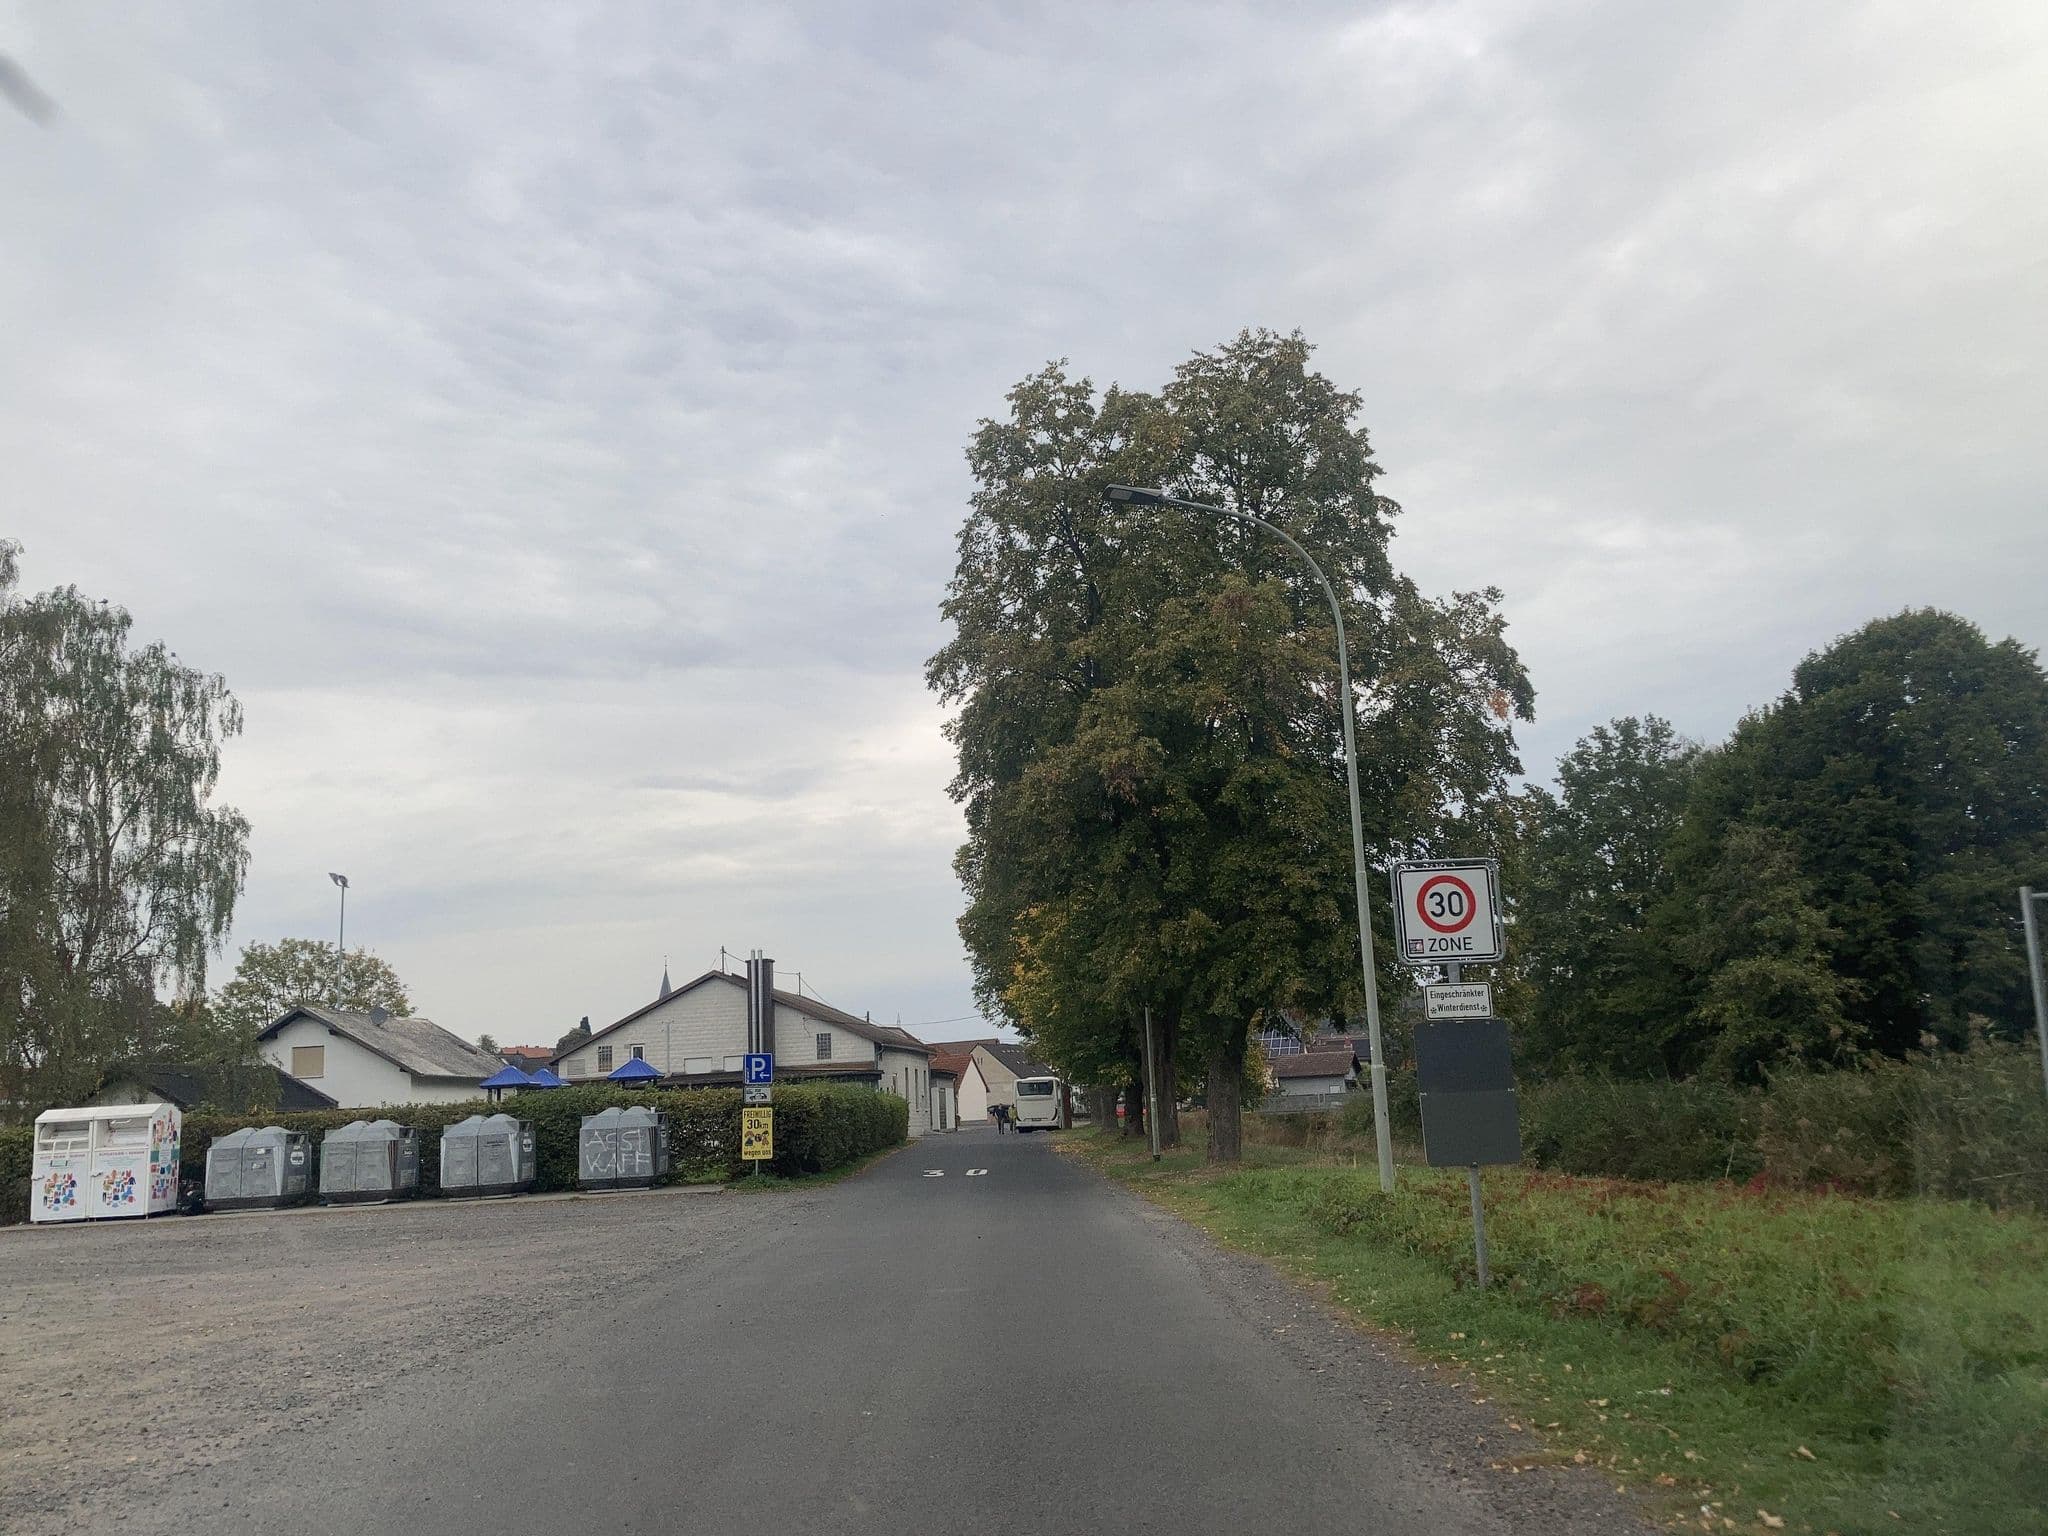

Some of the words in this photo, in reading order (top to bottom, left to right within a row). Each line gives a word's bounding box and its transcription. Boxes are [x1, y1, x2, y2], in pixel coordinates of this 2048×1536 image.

[1429, 891, 1464, 918] 30
[1428, 937, 1473, 952] ZONE
[1430, 989, 1485, 1000] Eingeschränkter
[1437, 1003, 1480, 1012] Winterdienst
[751, 1057, 766, 1080] P
[744, 1110, 772, 1118] FREIWILLIG
